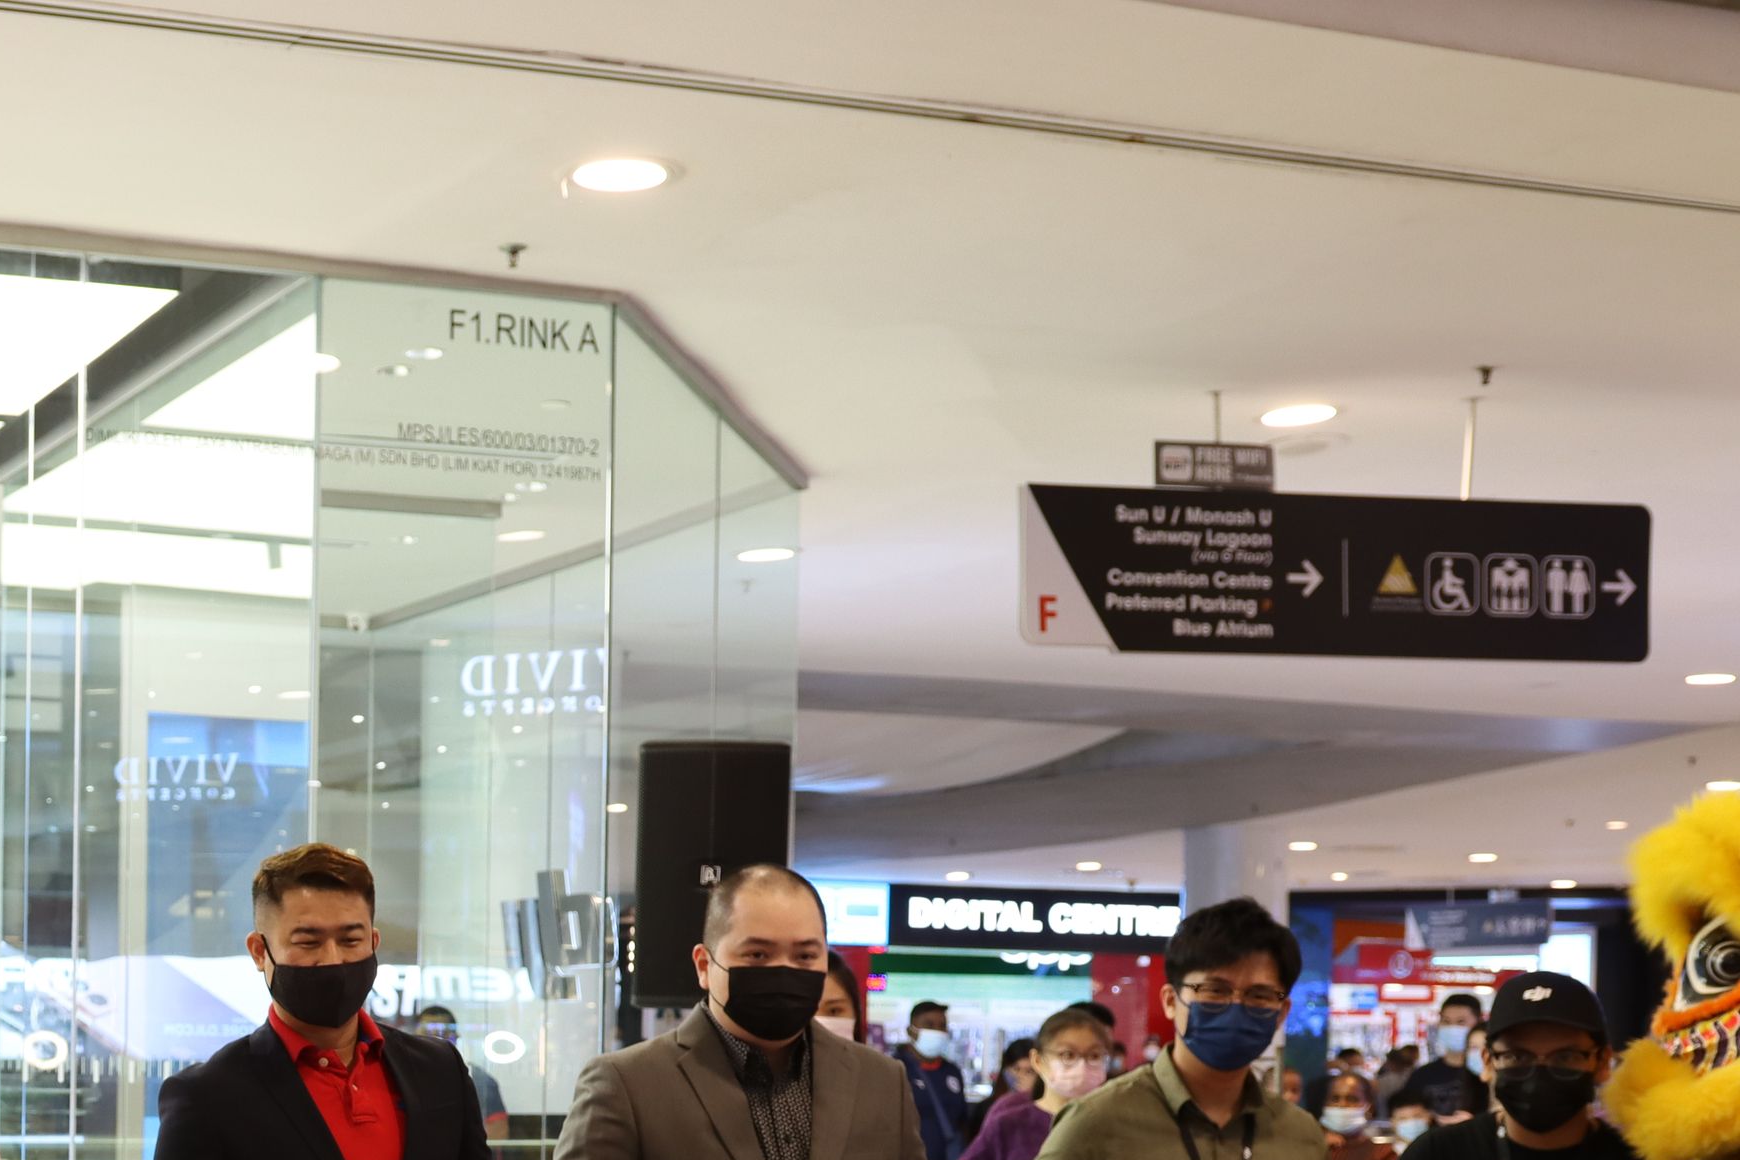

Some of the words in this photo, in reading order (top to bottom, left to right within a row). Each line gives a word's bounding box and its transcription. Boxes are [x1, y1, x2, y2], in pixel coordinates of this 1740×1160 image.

[449, 308, 571, 352] F1.RINK
[578, 322, 600, 354] A
[379, 448, 407, 466] SDN
[411, 453, 439, 470] BHD
[1115, 504, 1149, 523] Sun
[1152, 505, 1166, 524] U
[1185, 506, 1256, 526] Monash
[1259, 509, 1273, 528] U
[1133, 525, 1203, 548] Sunway
[1206, 528, 1273, 550] Lagoon
[1107, 567, 1209, 588] Convention
[1212, 570, 1273, 590] Centre
[1038, 595, 1058, 632] F
[1105, 592, 1186, 612] Preferred
[1190, 595, 1258, 618] Parking
[1172, 618, 1211, 637] Blue
[1215, 619, 1274, 638] Atrium
[907, 896, 1044, 934] DIGITAL
[1048, 902, 1183, 938] CENTRE
